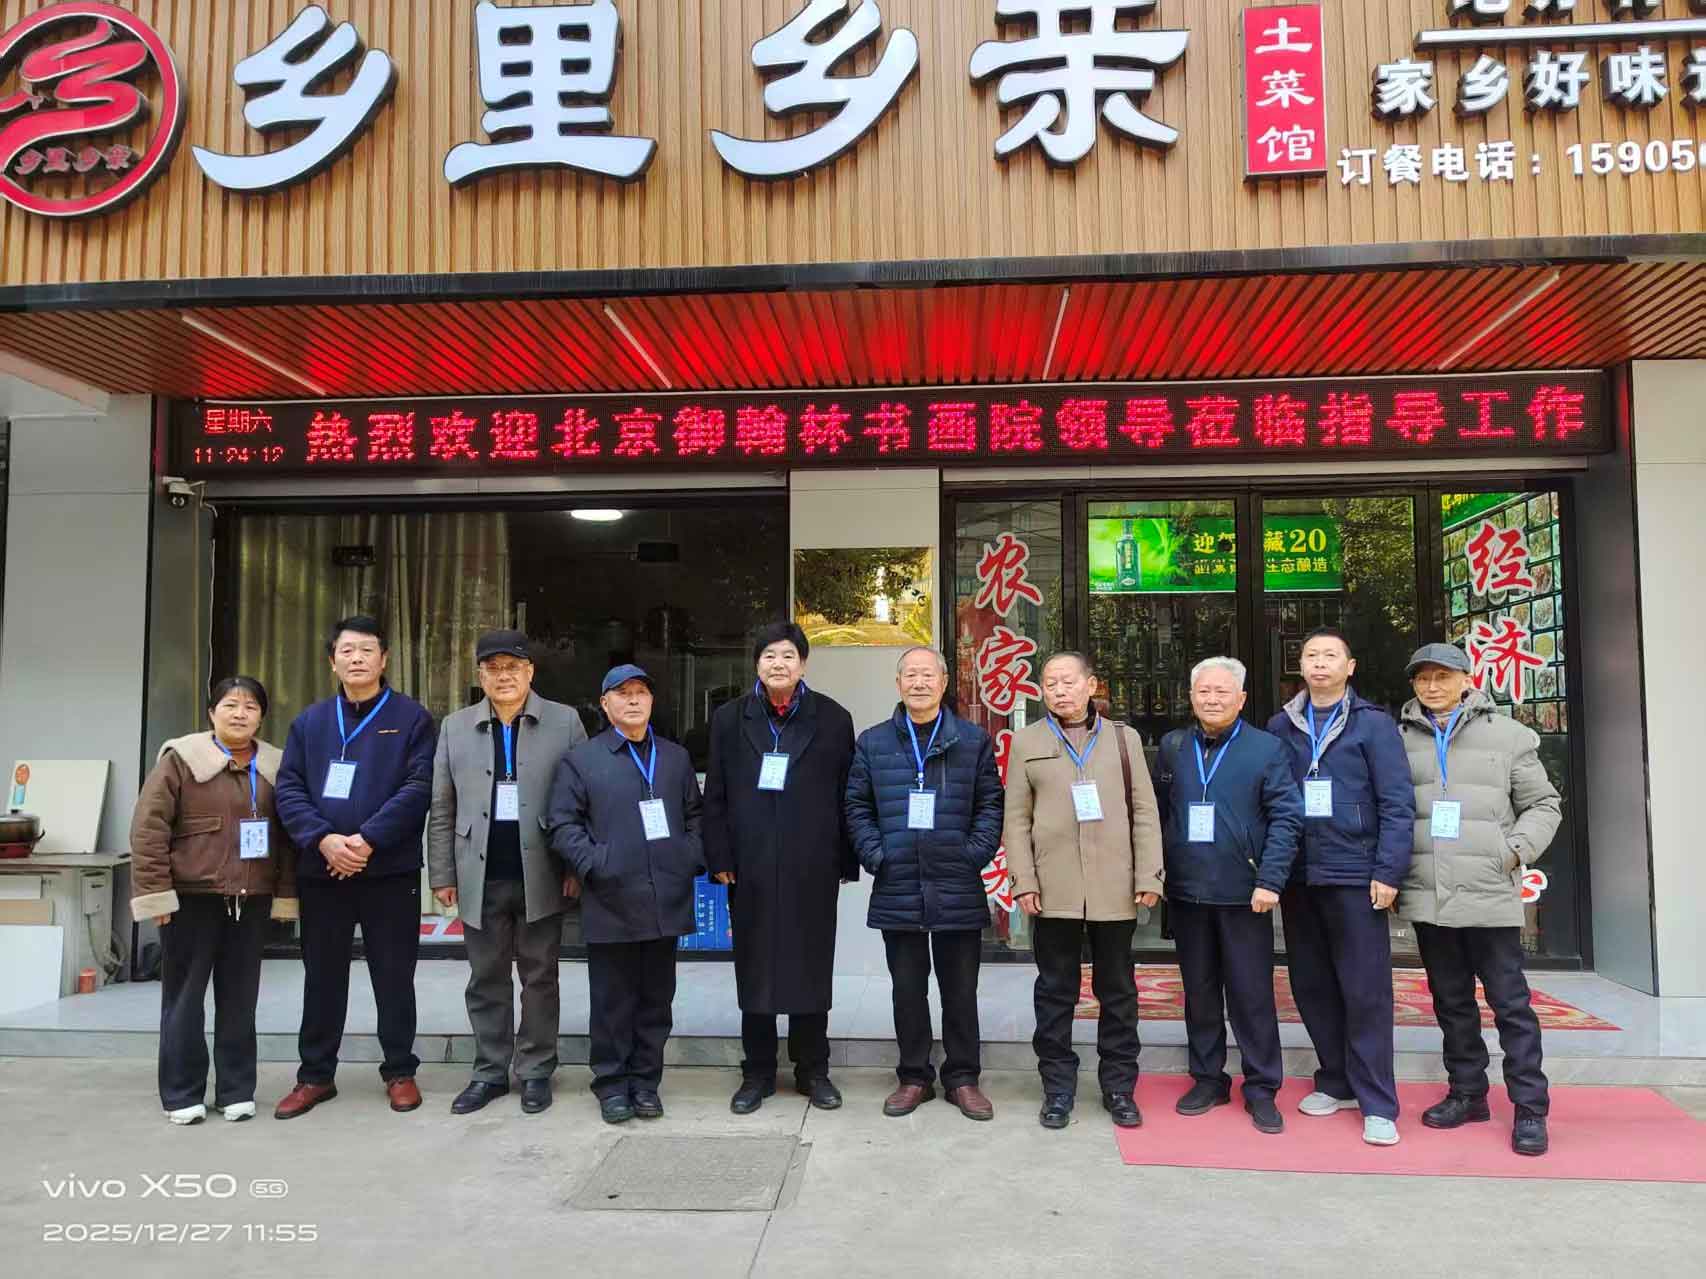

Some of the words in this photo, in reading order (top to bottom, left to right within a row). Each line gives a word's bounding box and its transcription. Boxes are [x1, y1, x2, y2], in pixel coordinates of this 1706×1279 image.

[193, 0, 1188, 189] 乡里乡亲
[1254, 17, 1315, 163] 土菜馆
[205, 408, 272, 433] 星期六
